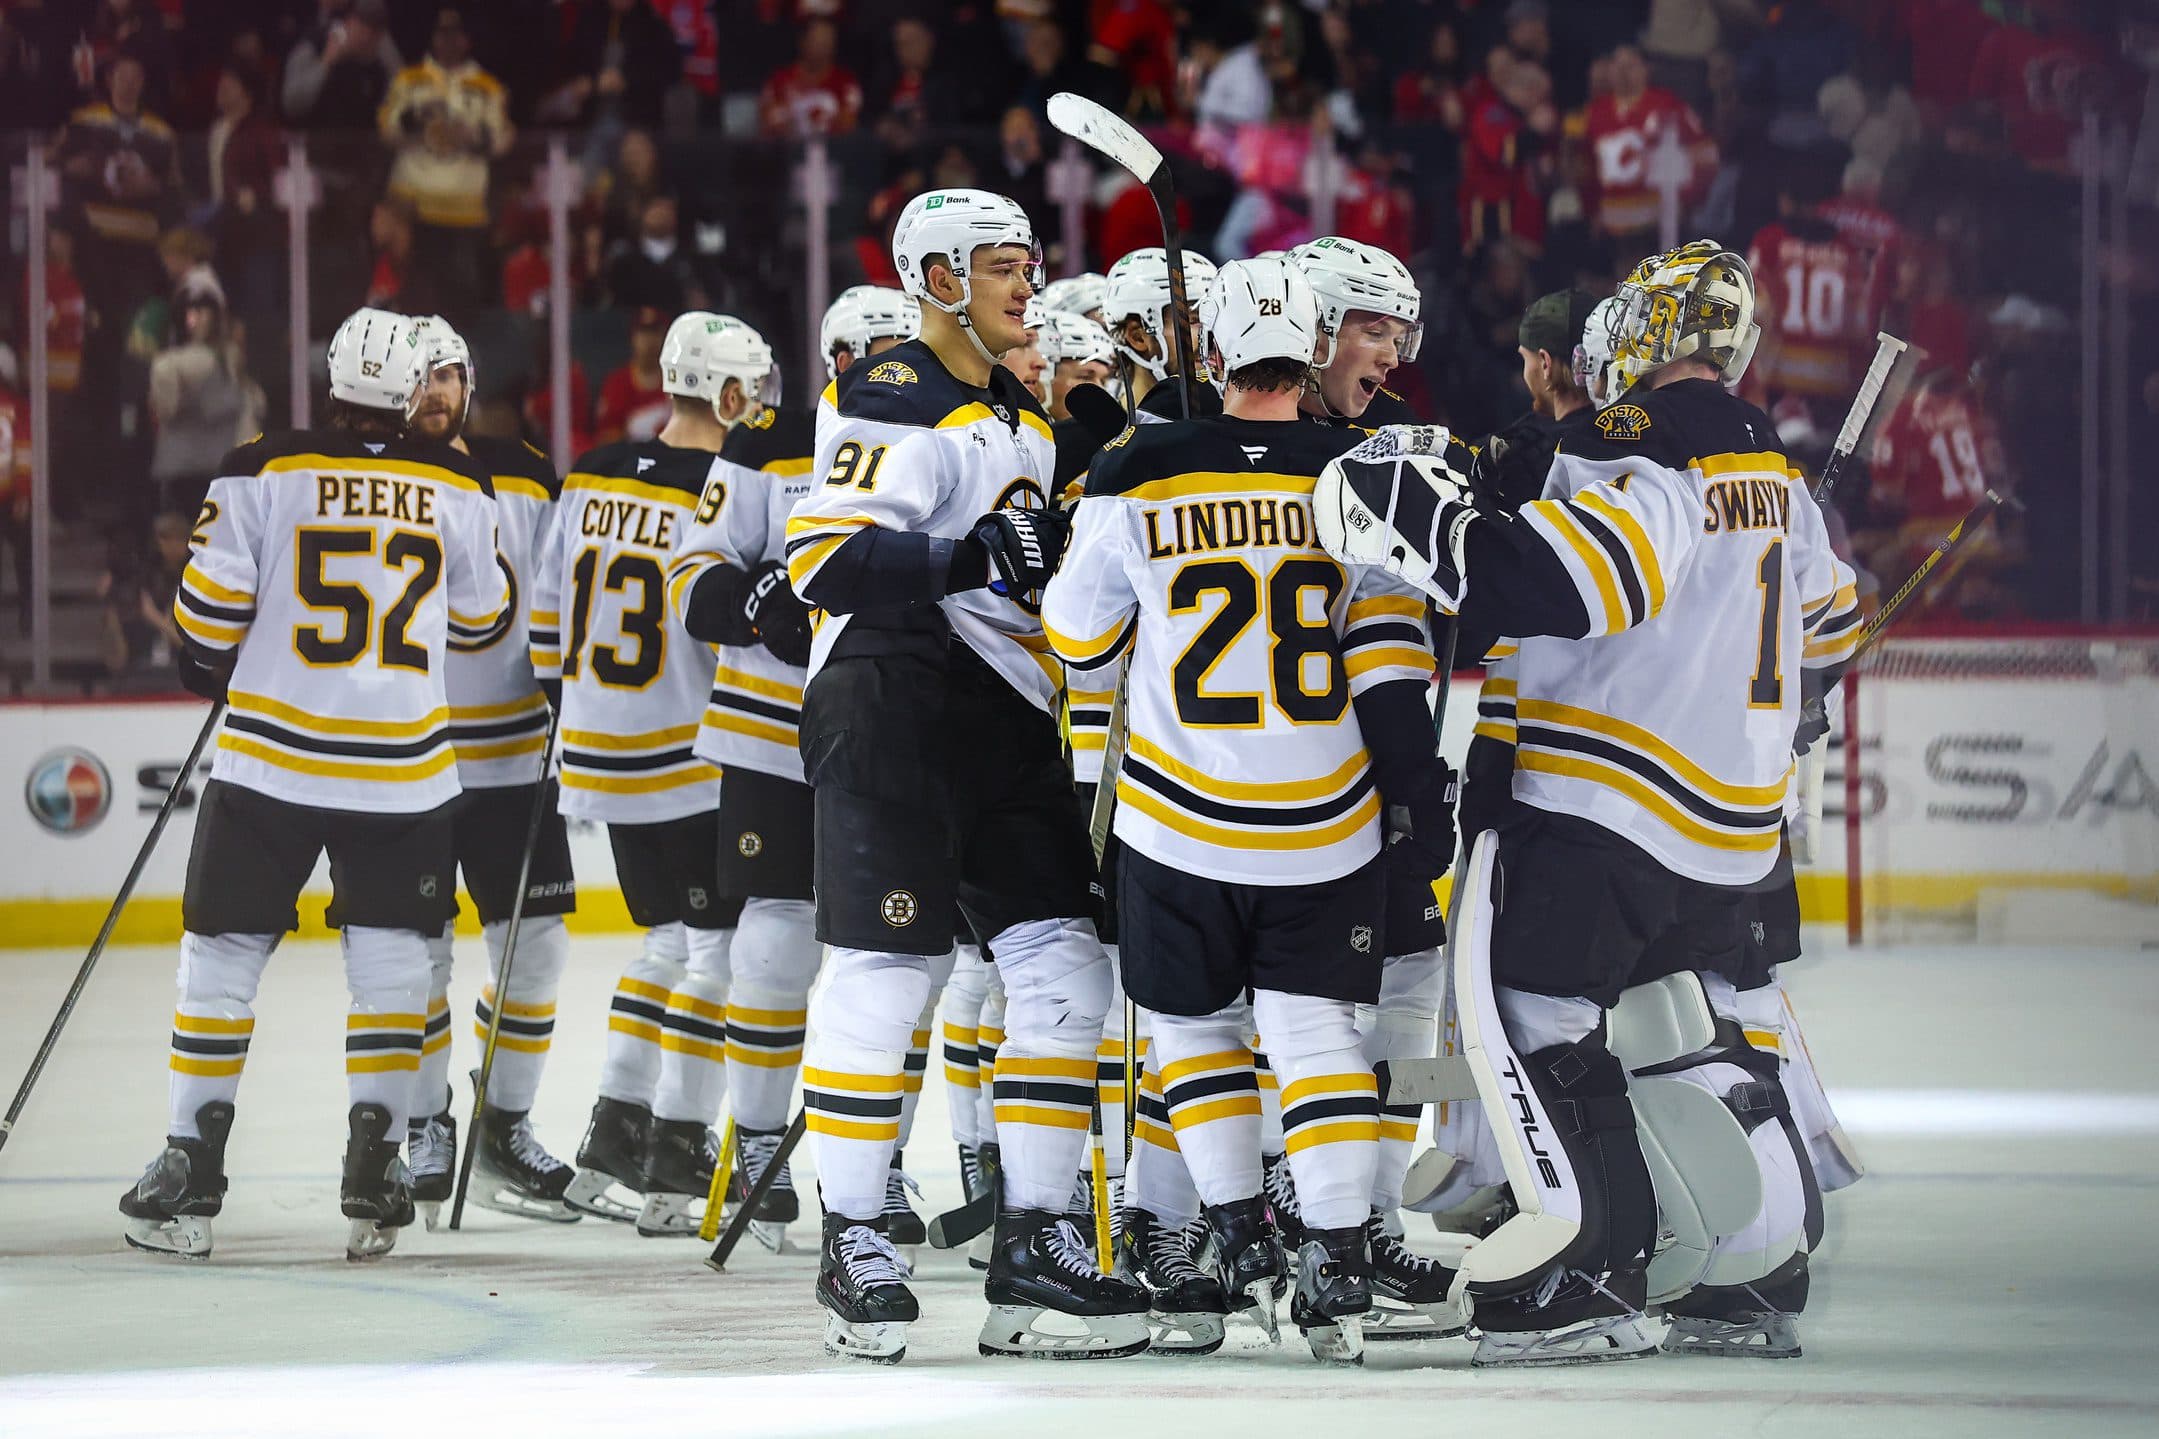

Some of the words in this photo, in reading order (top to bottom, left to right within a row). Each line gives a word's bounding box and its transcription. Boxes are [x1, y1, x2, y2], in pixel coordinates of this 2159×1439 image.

[946, 196, 970, 204] Bank
[1334, 242, 1356, 255] Bank
[1258, 299, 1282, 316] 28
[1782, 266, 1845, 336] 10
[361, 360, 382, 378] 52
[1597, 406, 1650, 429] BOSTON
[826, 440, 890, 493] 91
[188, 500, 221, 547] 2
[316, 475, 436, 525] PEEKE
[581, 498, 675, 550] COYLE
[694, 481, 727, 526] 9
[292, 525, 443, 676] 52
[562, 545, 668, 692] 13
[1747, 537, 1783, 710] 1
[1168, 555, 1351, 729] 28
[1503, 1055, 1562, 1188] TRUE
[1036, 1274, 1072, 1293] BAUER
